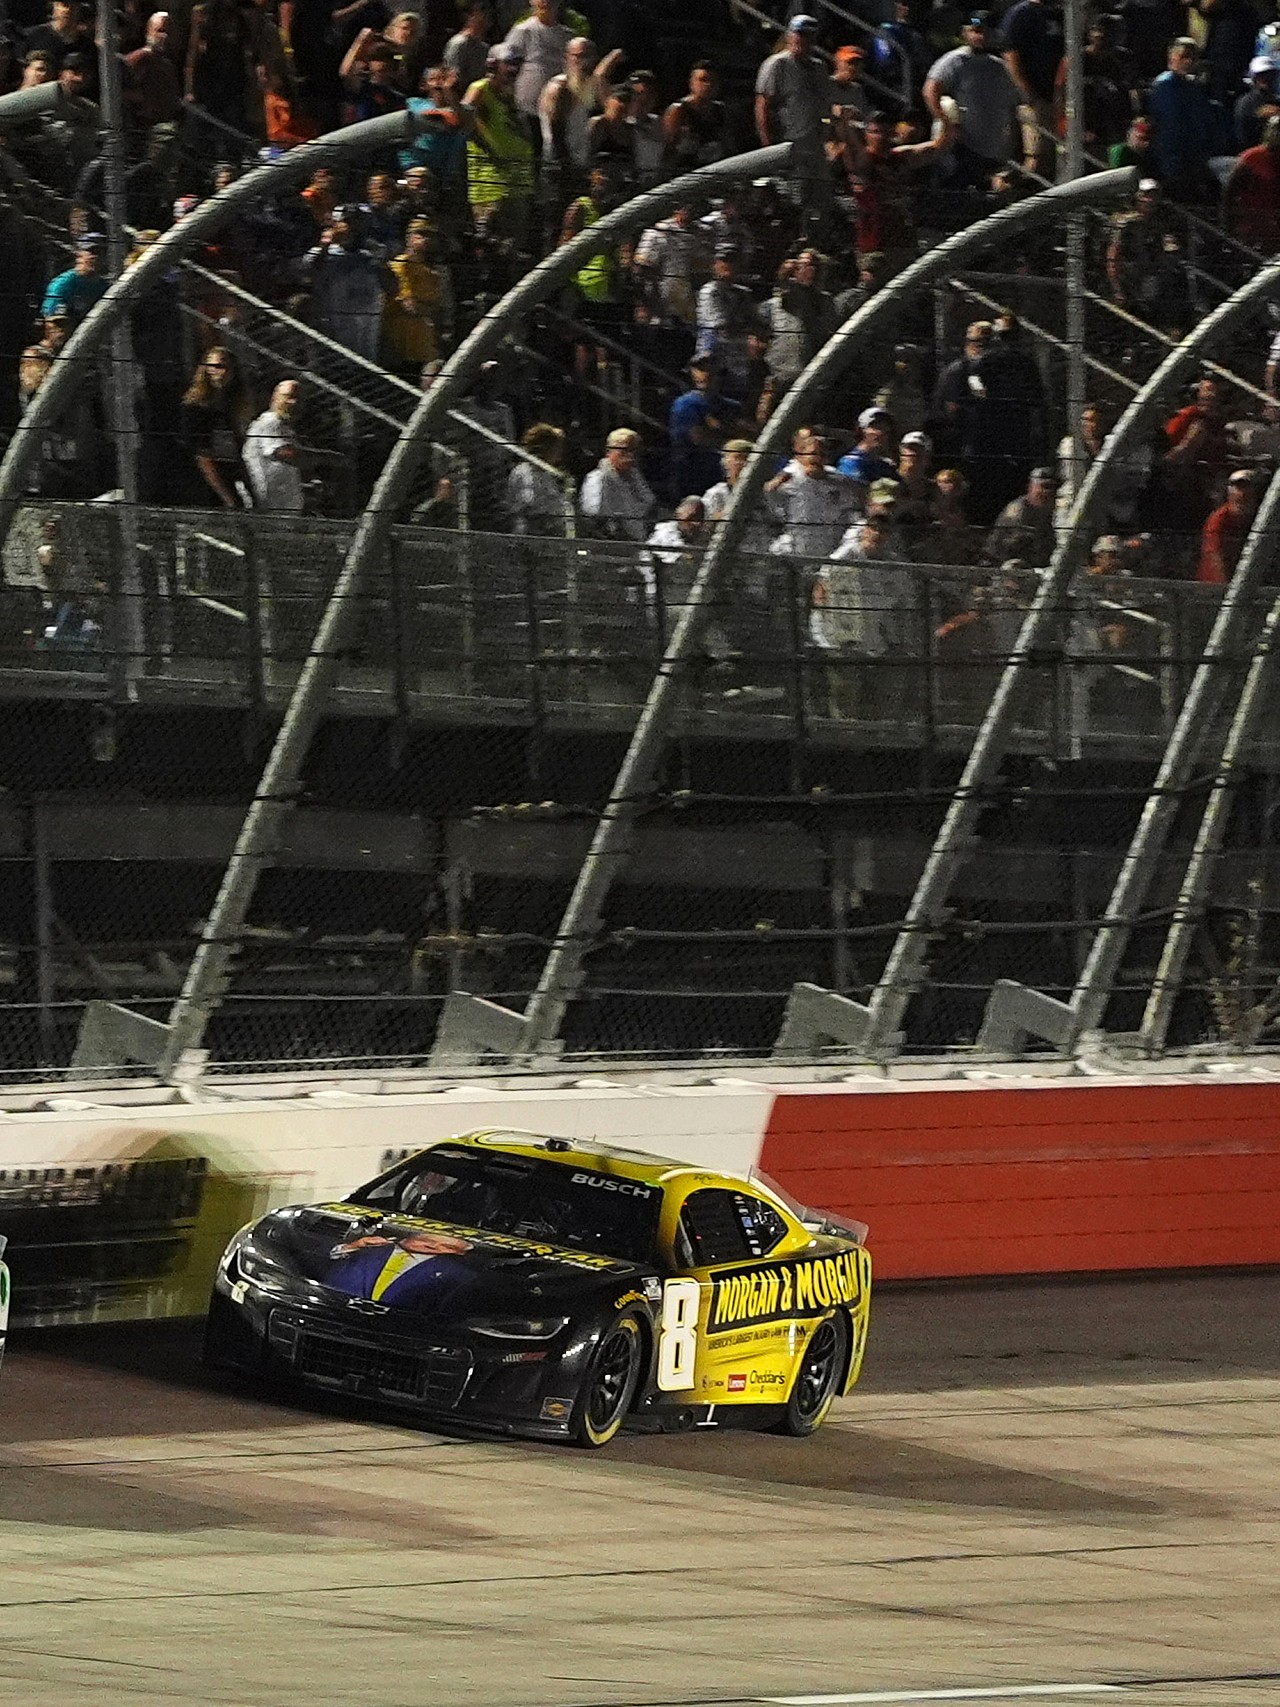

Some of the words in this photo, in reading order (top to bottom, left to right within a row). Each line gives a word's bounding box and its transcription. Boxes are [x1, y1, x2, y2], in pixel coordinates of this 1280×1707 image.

[571, 1173, 651, 1199] BUSCH
[714, 1269, 781, 1325] MORGAN
[780, 1266, 793, 1311] &
[795, 1250, 859, 1310] MORGAN
[657, 1277, 700, 1391] 8
